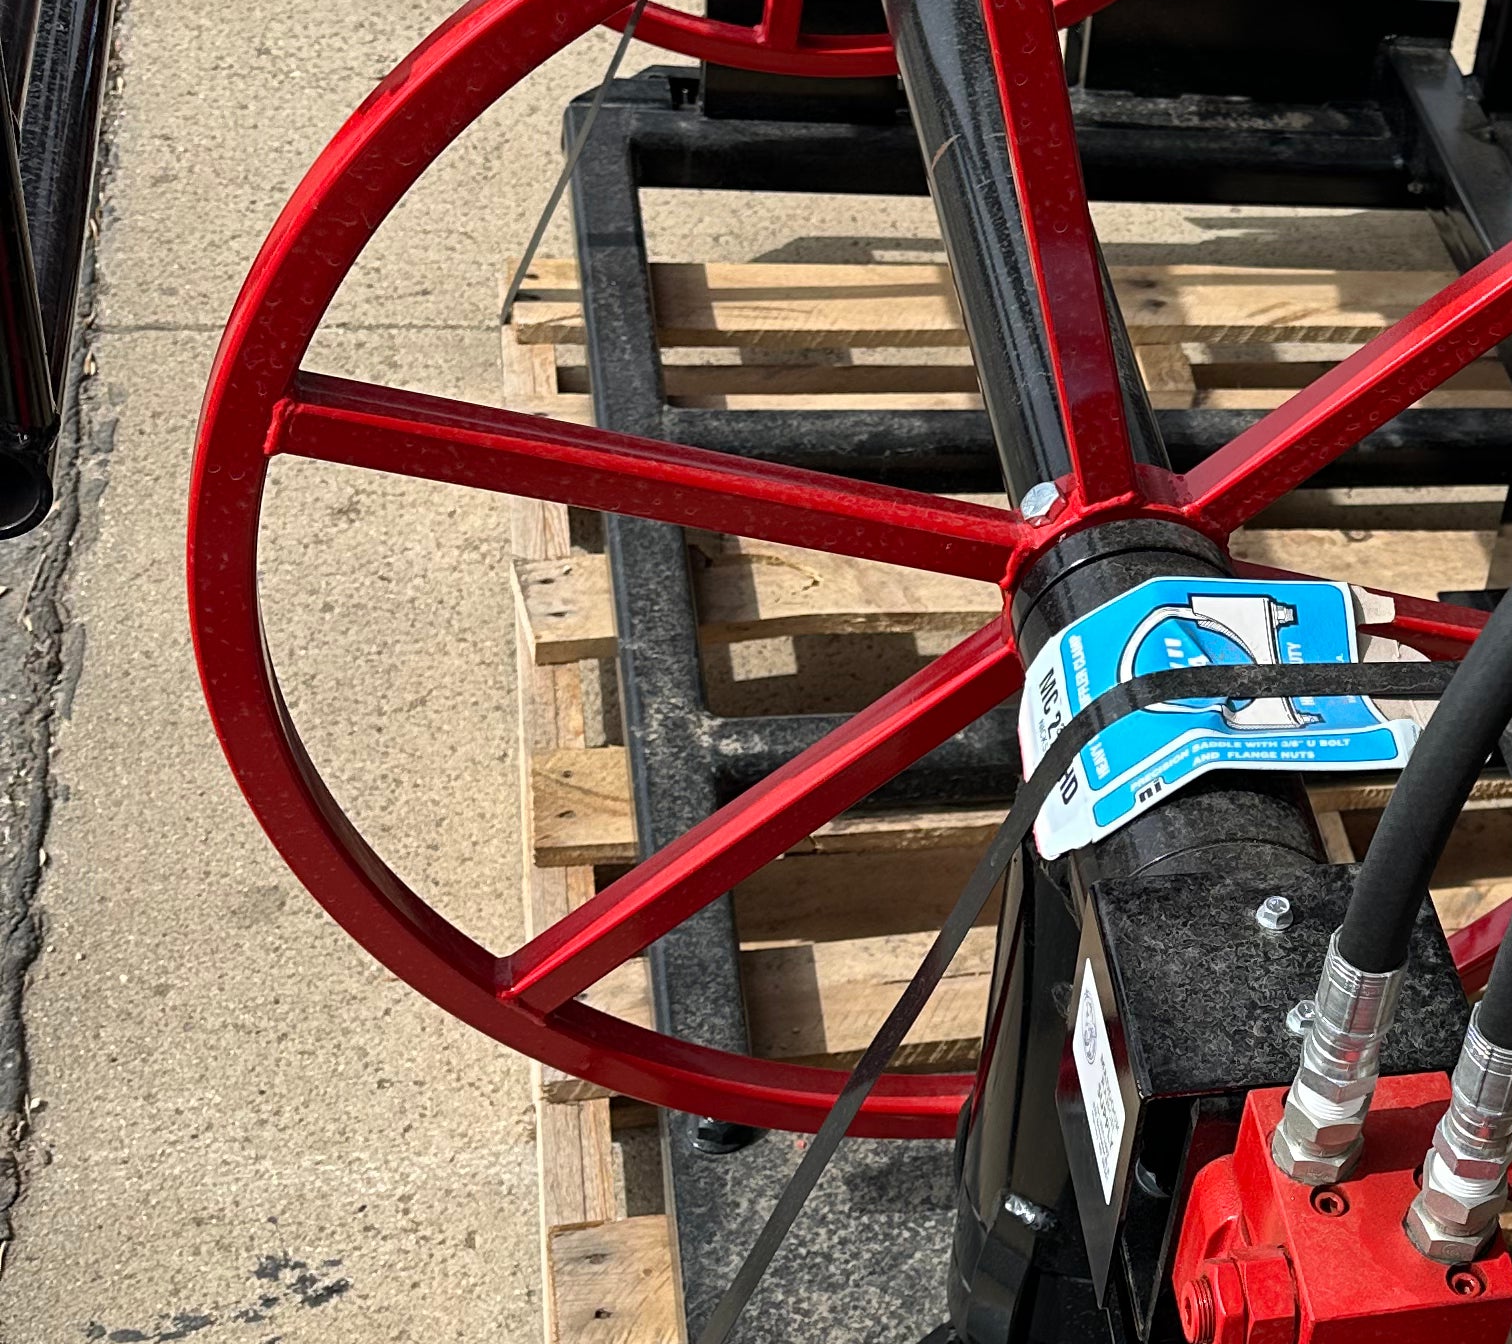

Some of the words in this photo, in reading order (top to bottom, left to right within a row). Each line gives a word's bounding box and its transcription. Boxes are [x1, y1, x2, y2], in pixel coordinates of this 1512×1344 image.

[1039, 666, 1059, 716] MC
[1191, 740, 1243, 755] SADDLE
[1245, 740, 1279, 749] WITH
[1306, 738, 1317, 748] U
[1319, 738, 1351, 748] BOLT
[1192, 751, 1221, 767] AND
[1227, 751, 1278, 760] FLANGE
[1281, 750, 1316, 760] NUTS
